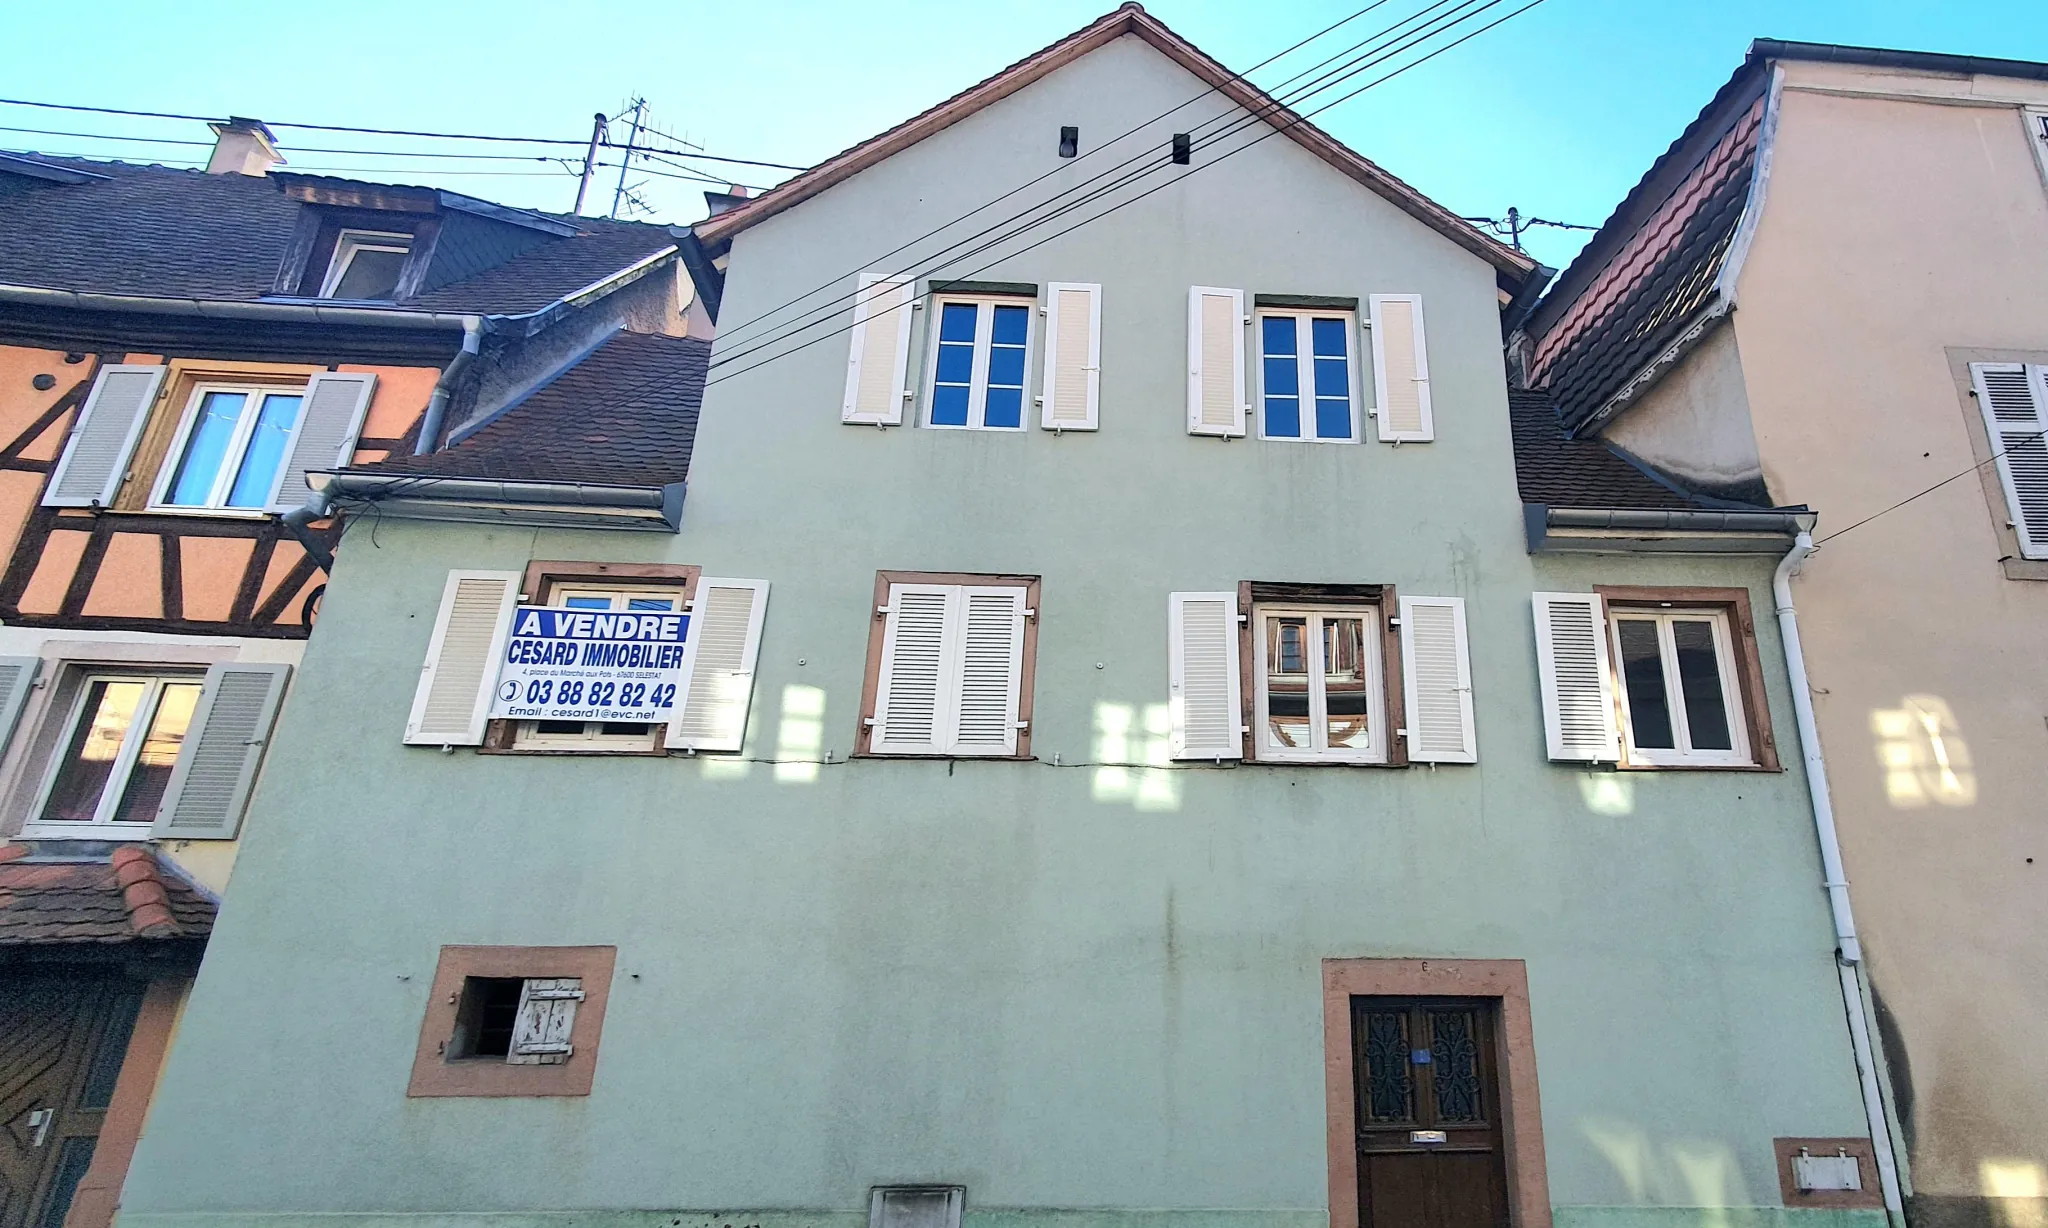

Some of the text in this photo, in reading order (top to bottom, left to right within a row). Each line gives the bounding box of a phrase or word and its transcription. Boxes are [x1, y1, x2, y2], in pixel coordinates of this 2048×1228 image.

[518, 611, 681, 641] A VENDRE
[508, 639, 684, 669] CESARD IMMOBILIER
[560, 669, 584, 677] Marché
[635, 671, 662, 679] SELESTAT
[526, 679, 676, 708] 03 88 82 82 42
[508, 706, 542, 716] Email
[551, 708, 656, 720] cesard1@evc.net
